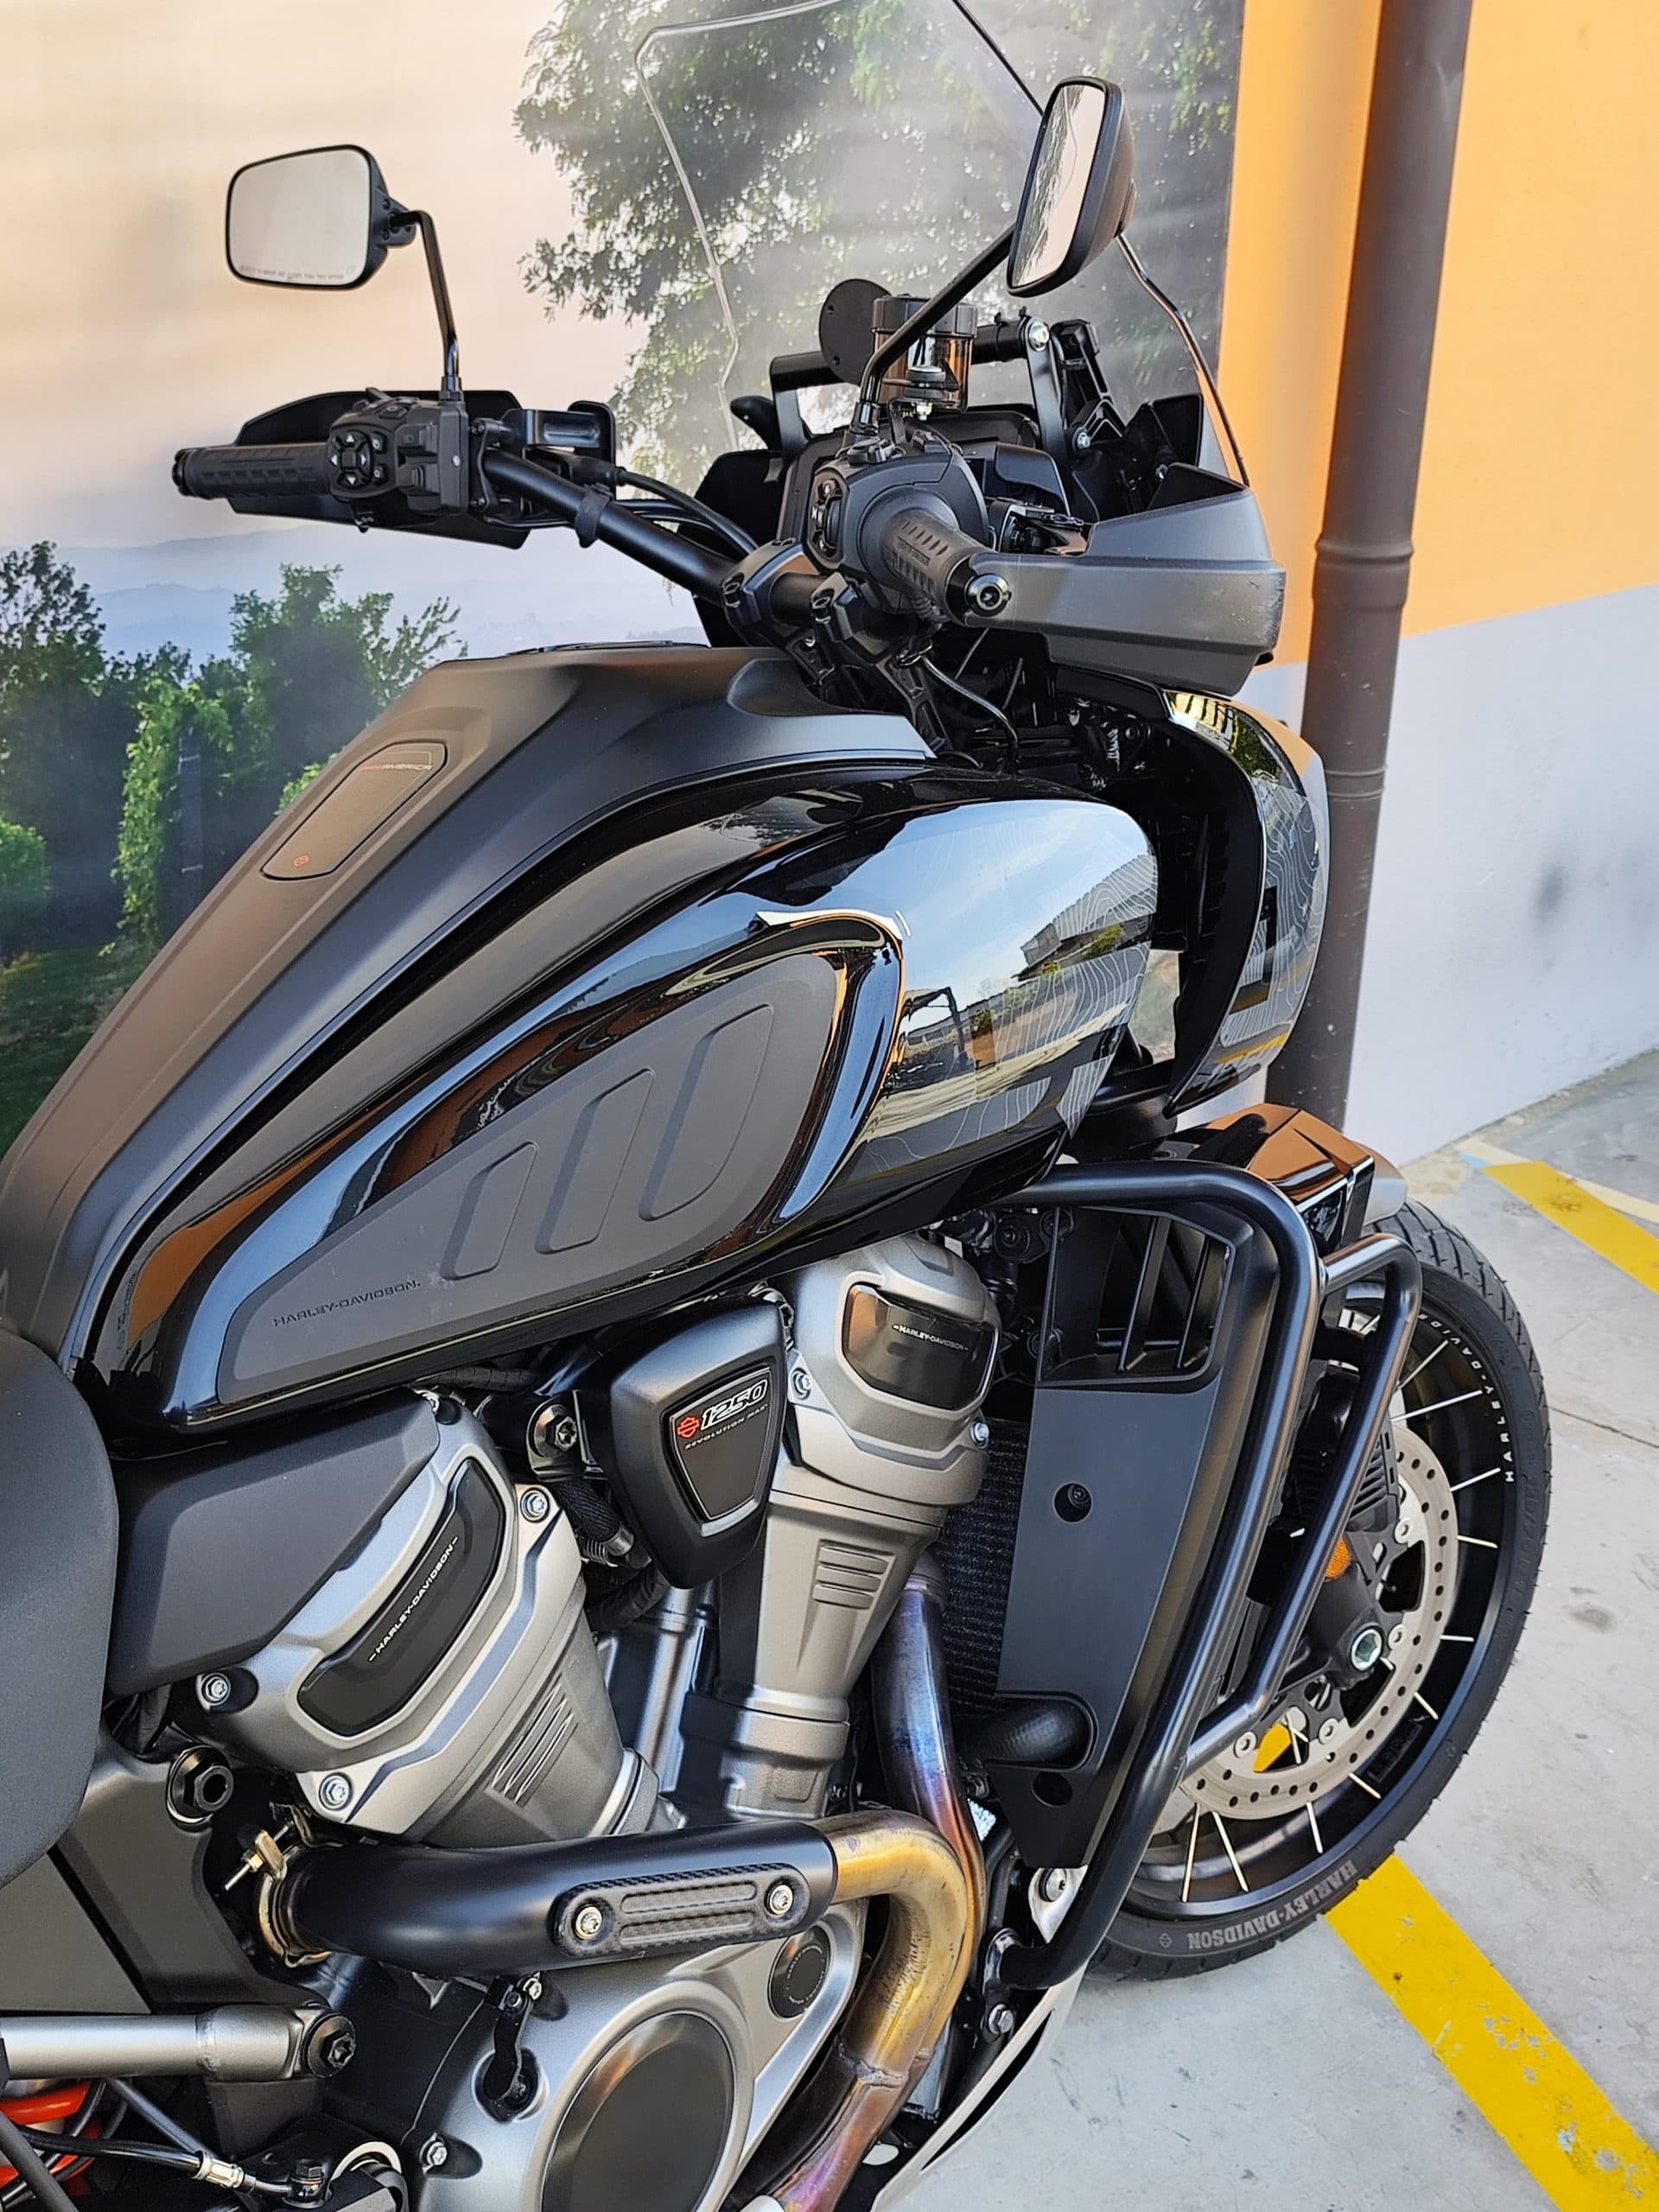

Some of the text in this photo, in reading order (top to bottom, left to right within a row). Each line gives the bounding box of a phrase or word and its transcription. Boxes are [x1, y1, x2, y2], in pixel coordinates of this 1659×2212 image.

[684, 1416, 745, 1451] REVOLUTION
[700, 1378, 768, 1432] 1250
[1418, 1313, 1515, 1483] HARLEY-DAVIDS
[1188, 1859, 1358, 1950] HARLEY-DAVIDSON
